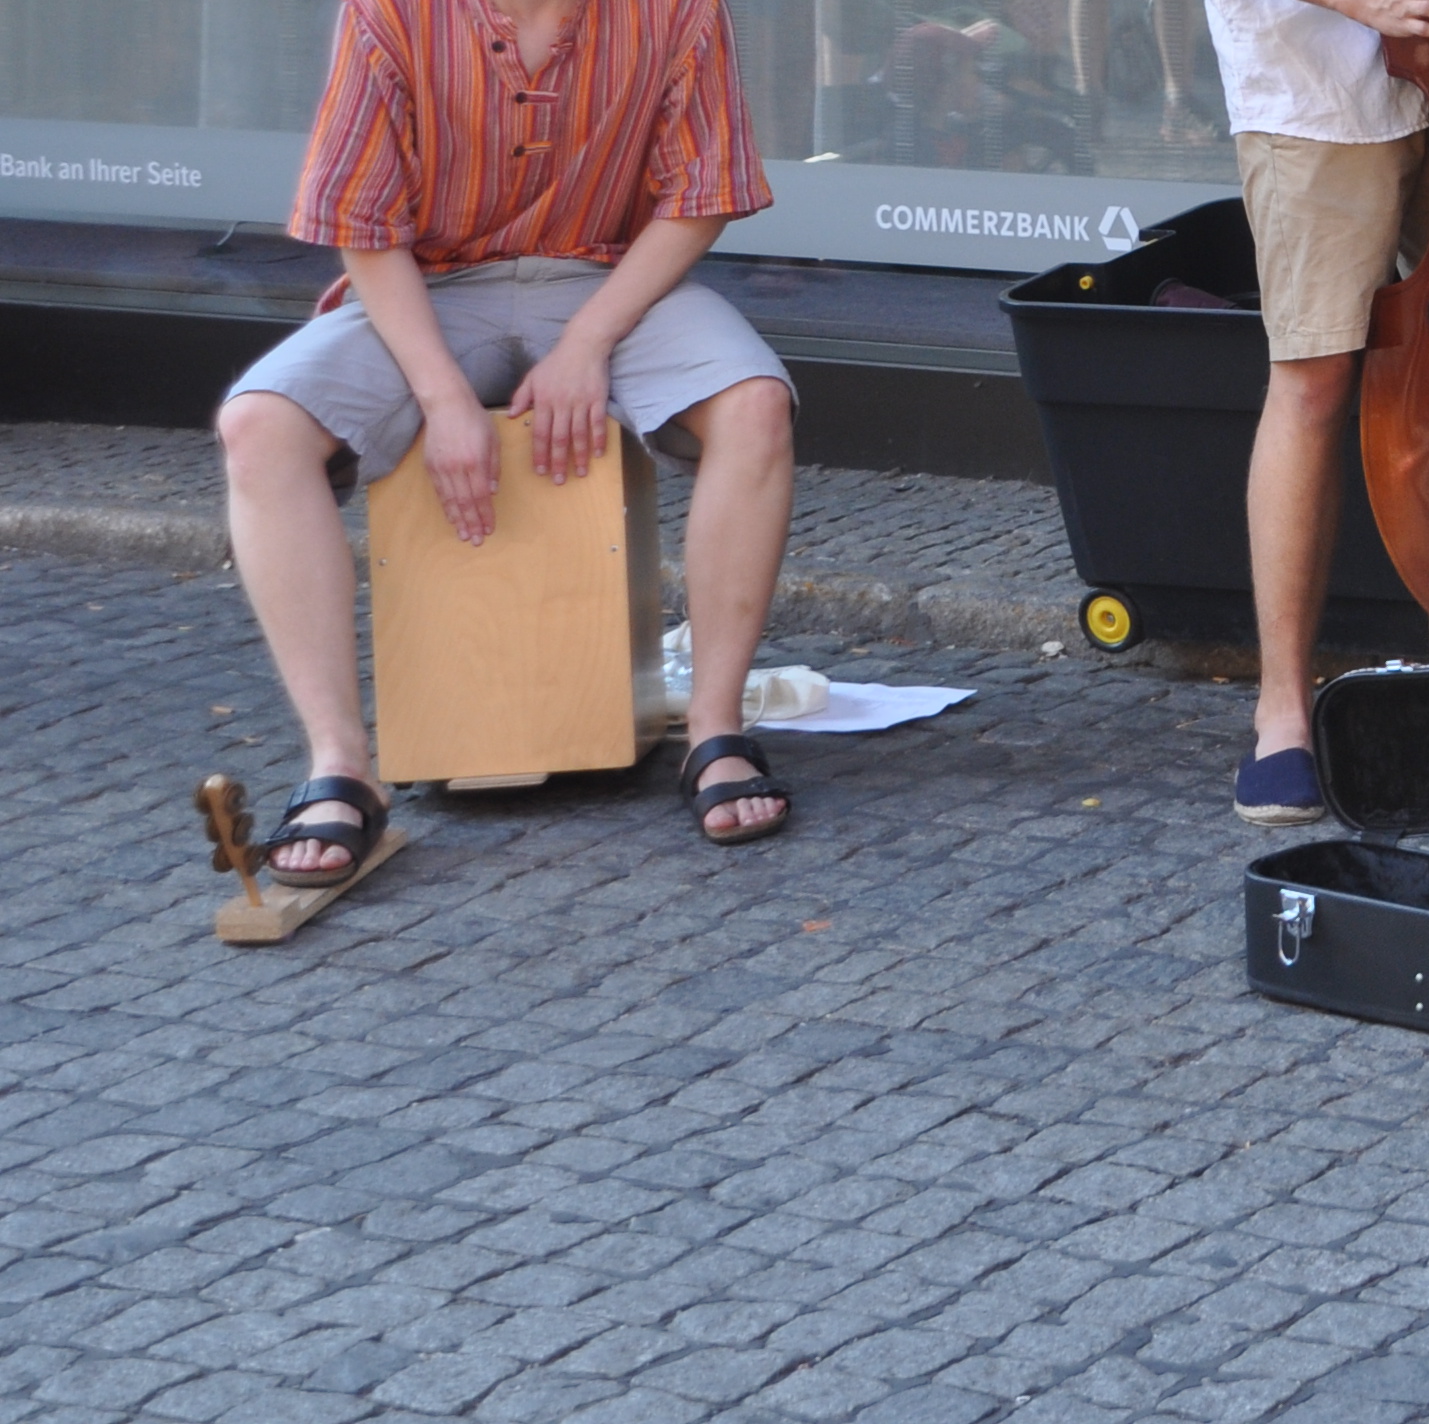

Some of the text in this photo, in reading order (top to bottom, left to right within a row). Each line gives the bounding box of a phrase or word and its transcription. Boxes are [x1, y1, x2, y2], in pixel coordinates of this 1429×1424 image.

[0, 153, 202, 187] Bank an Ihrer Seite
[875, 203, 1091, 242] COMMERZBANK
